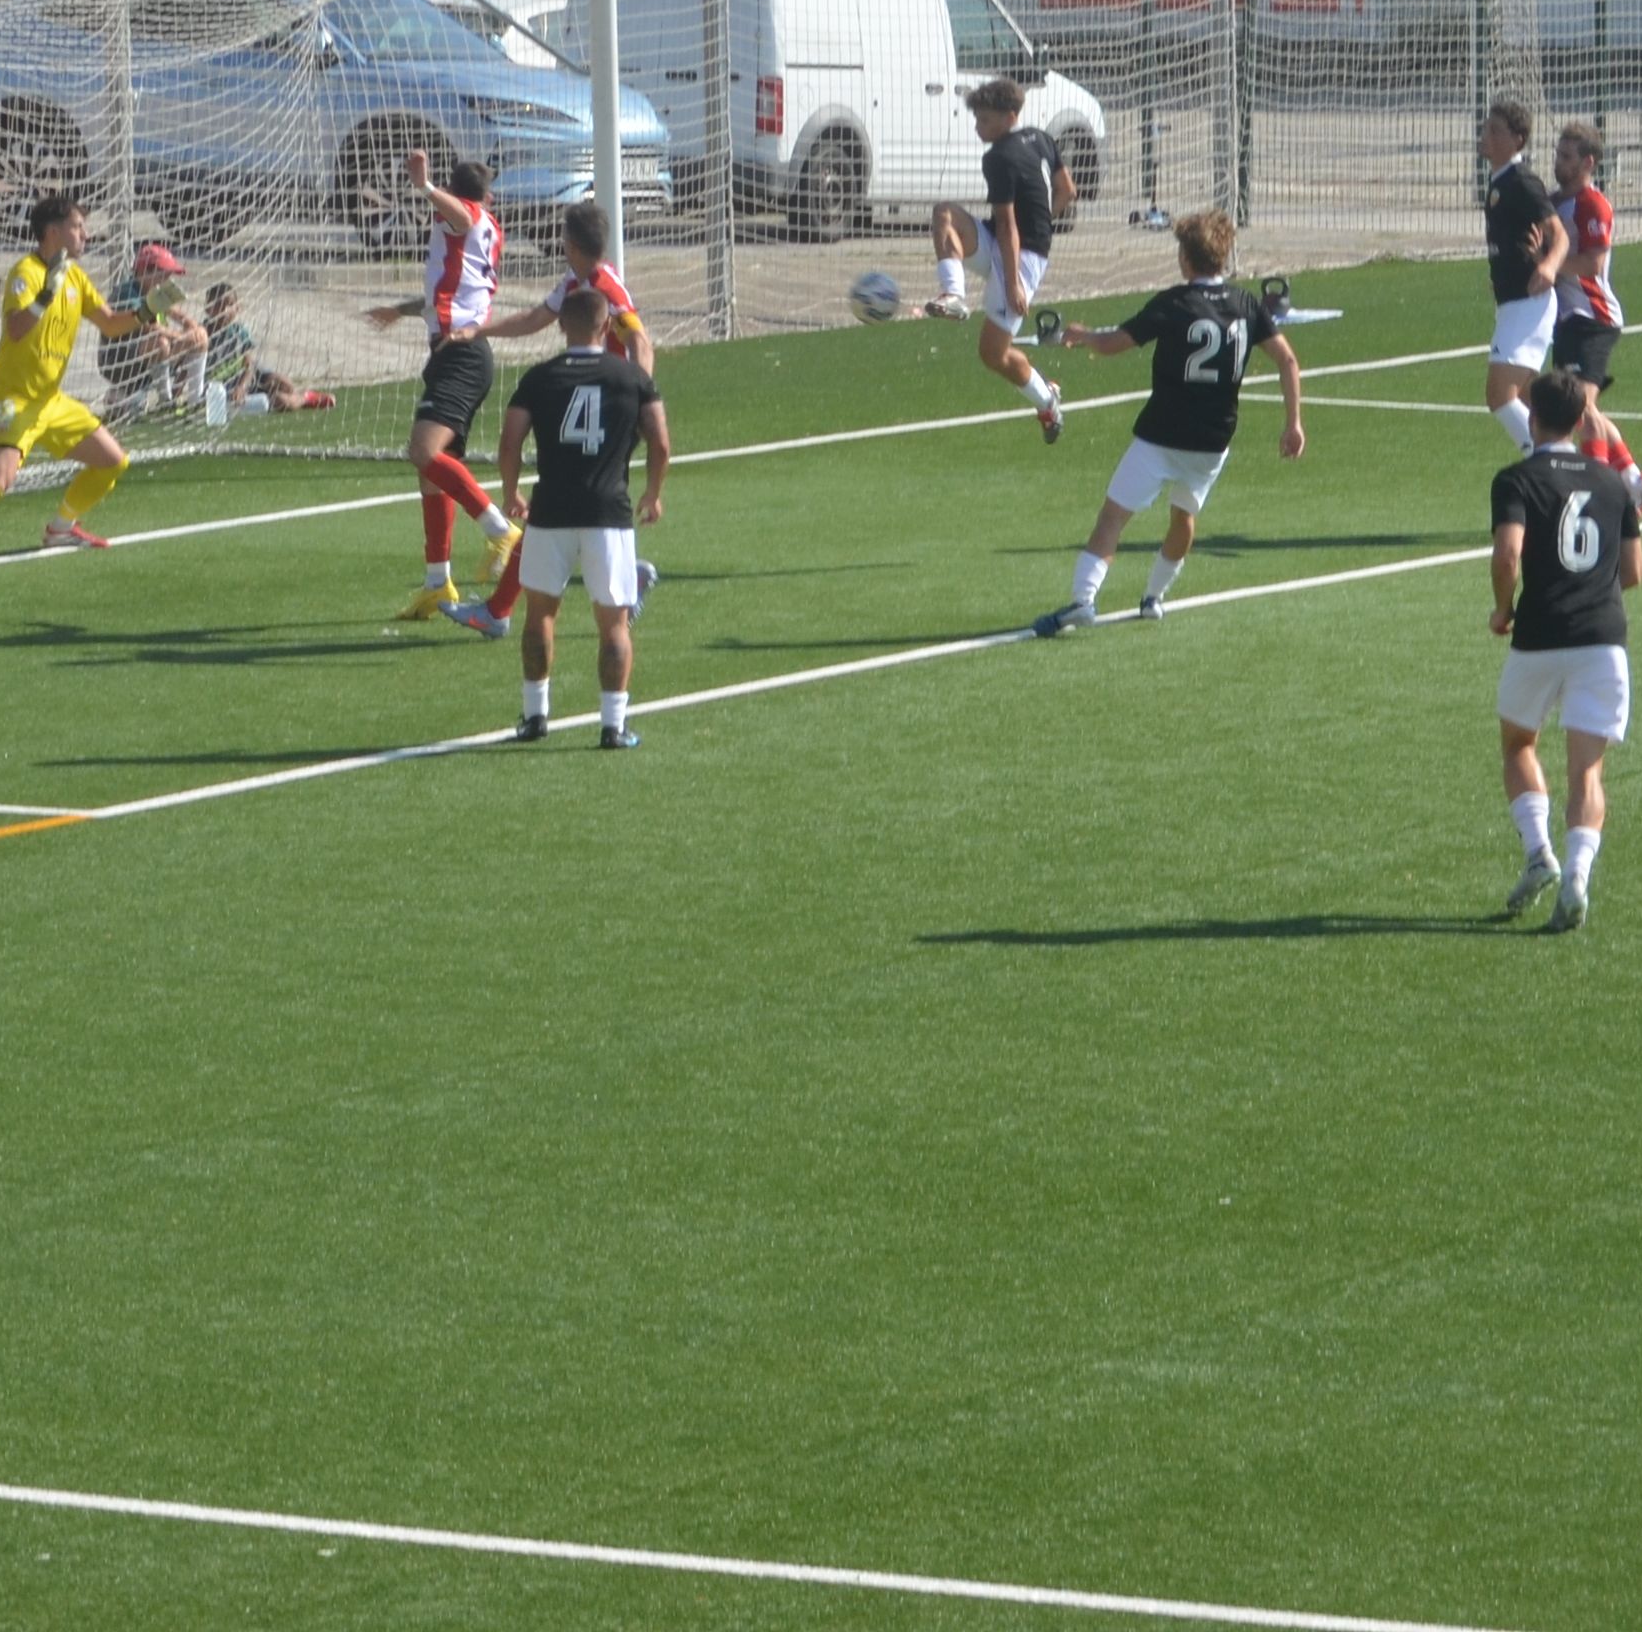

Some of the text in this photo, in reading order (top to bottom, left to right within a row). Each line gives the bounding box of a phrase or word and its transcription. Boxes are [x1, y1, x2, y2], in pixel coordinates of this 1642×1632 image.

[1184, 317, 1249, 384] 21
[559, 384, 606, 456] 4
[1557, 490, 1600, 573] 6
